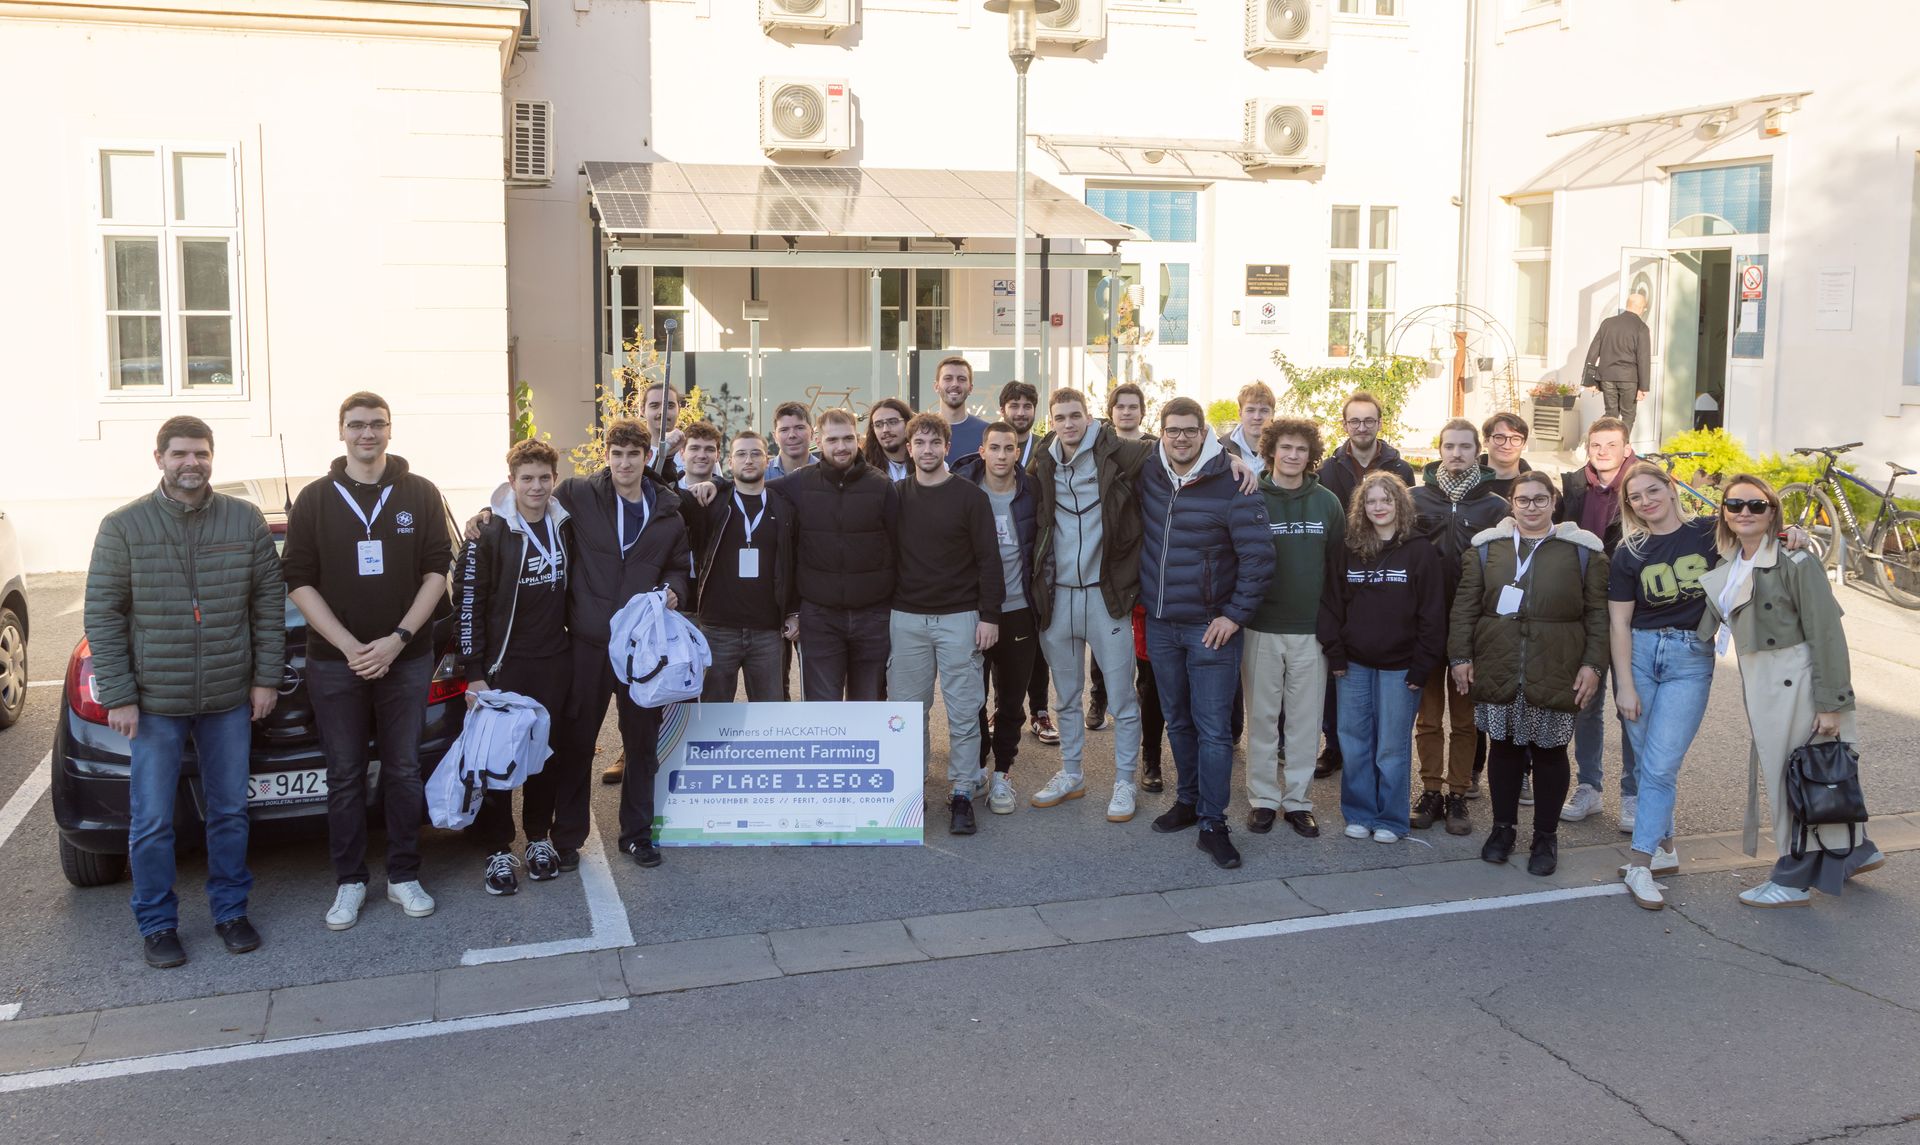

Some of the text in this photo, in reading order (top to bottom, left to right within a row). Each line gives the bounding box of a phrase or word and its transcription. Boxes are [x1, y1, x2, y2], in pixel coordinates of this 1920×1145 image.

[461, 541, 477, 656] ALPHA INDUSTRIES
[718, 726, 847, 737] Winners of HACKATHON
[689, 744, 876, 762] Reinforcement Farming
[712, 774, 783, 789] PLACE
[796, 773, 861, 789] 1.250
[868, 773, 883, 788] €
[667, 797, 678, 805] 12
[859, 796, 895, 804] CROATIA
